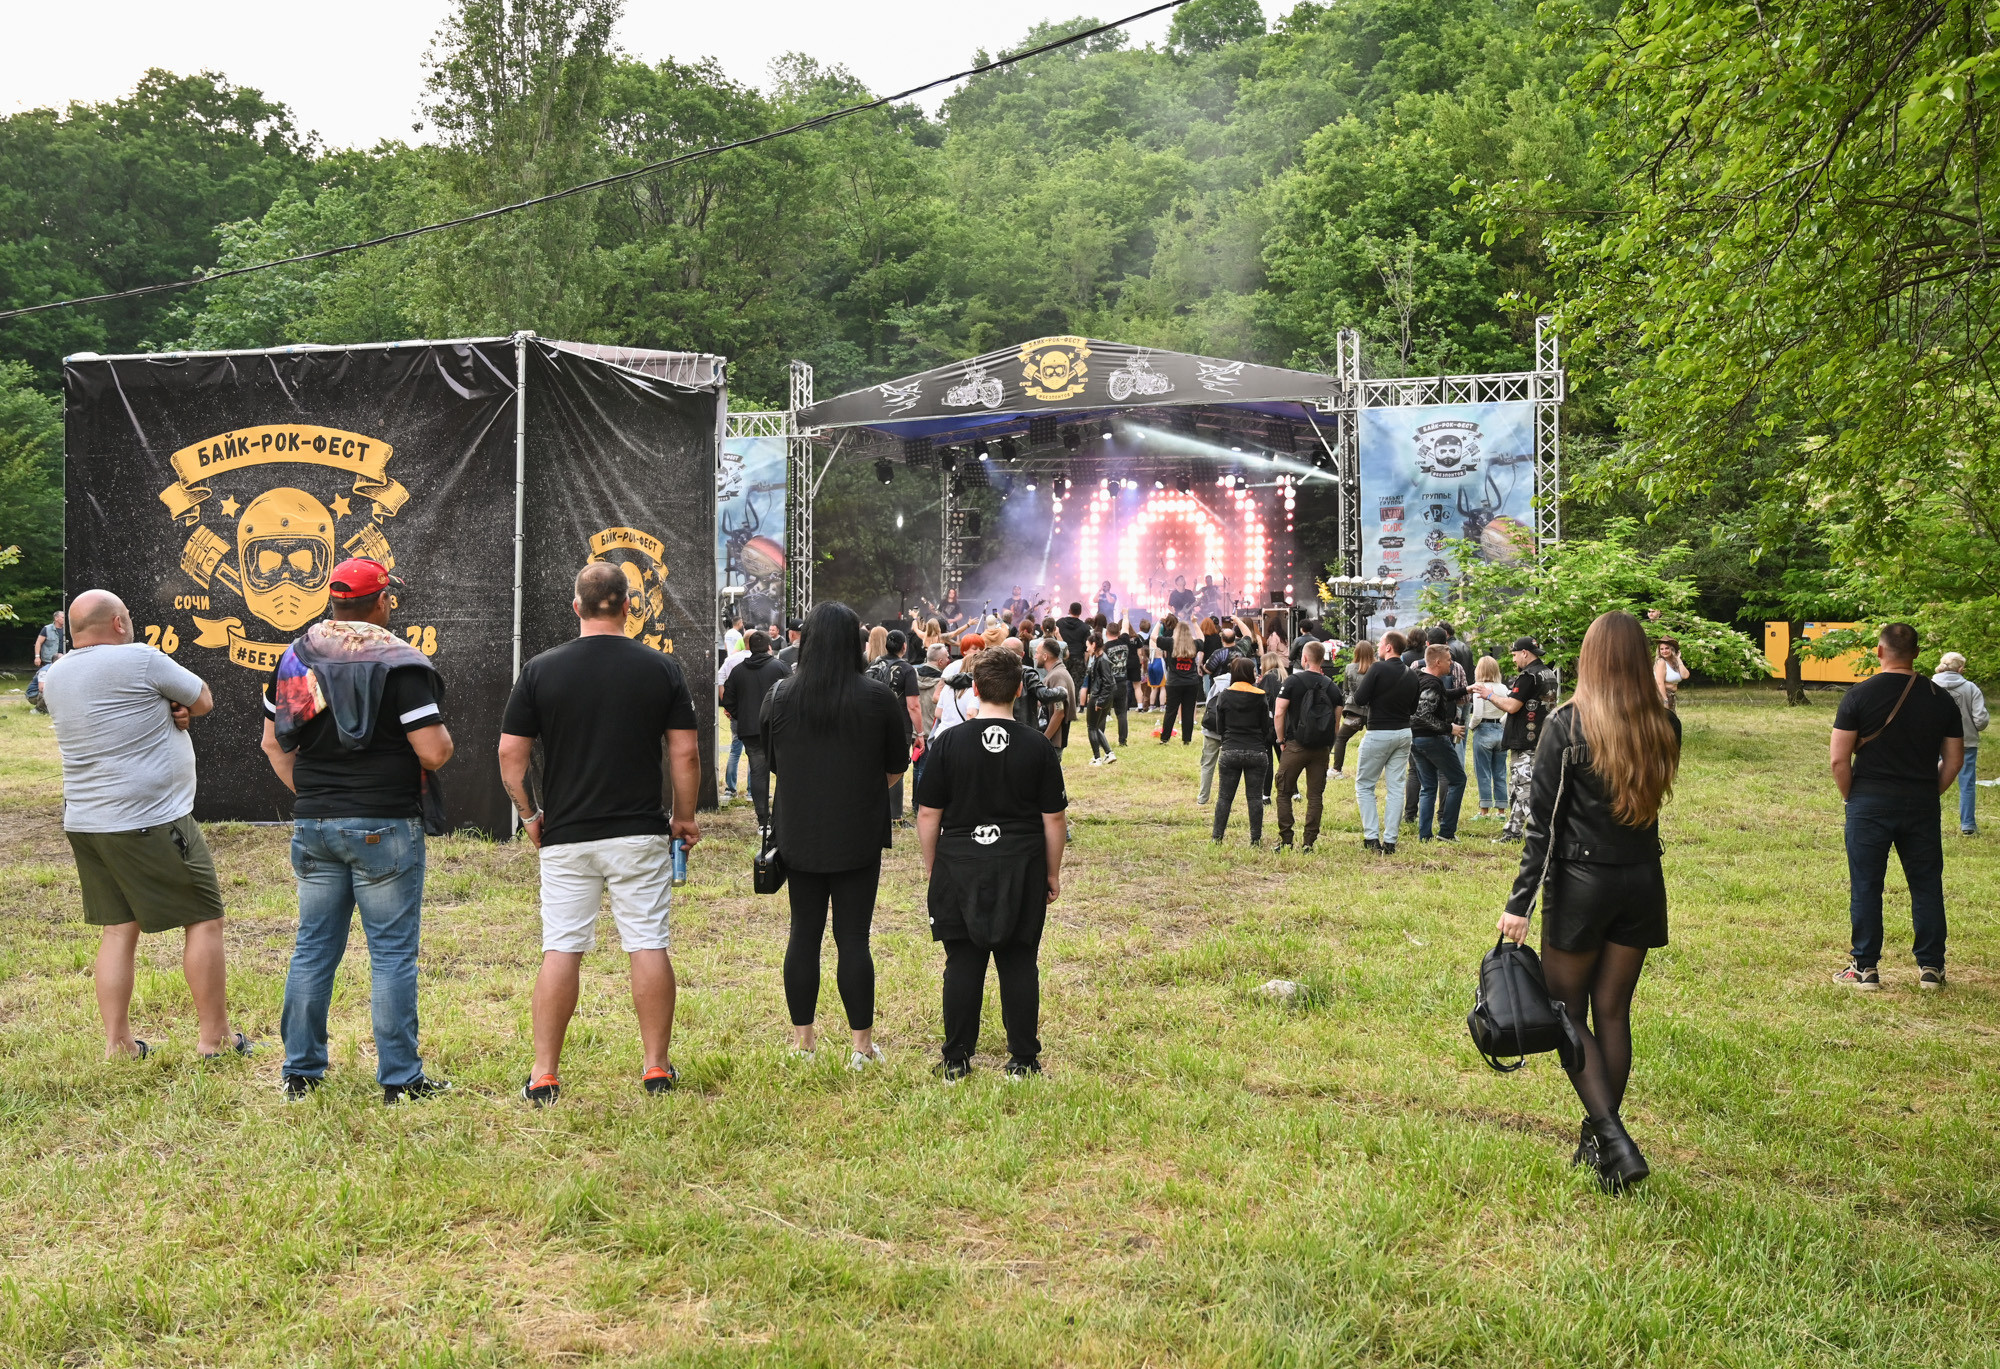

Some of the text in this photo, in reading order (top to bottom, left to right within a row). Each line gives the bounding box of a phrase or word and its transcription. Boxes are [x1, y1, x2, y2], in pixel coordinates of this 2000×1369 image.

[1422, 421, 1474, 432] БАЙК-РОК-ФЕСТ
[197, 433, 370, 467] БАЙК-РОК-ФЕСТ
[174, 595, 210, 610] СОЧИ
[145, 624, 179, 654] 26
[406, 625, 438, 656] 28
[983, 732, 1009, 745] VN
